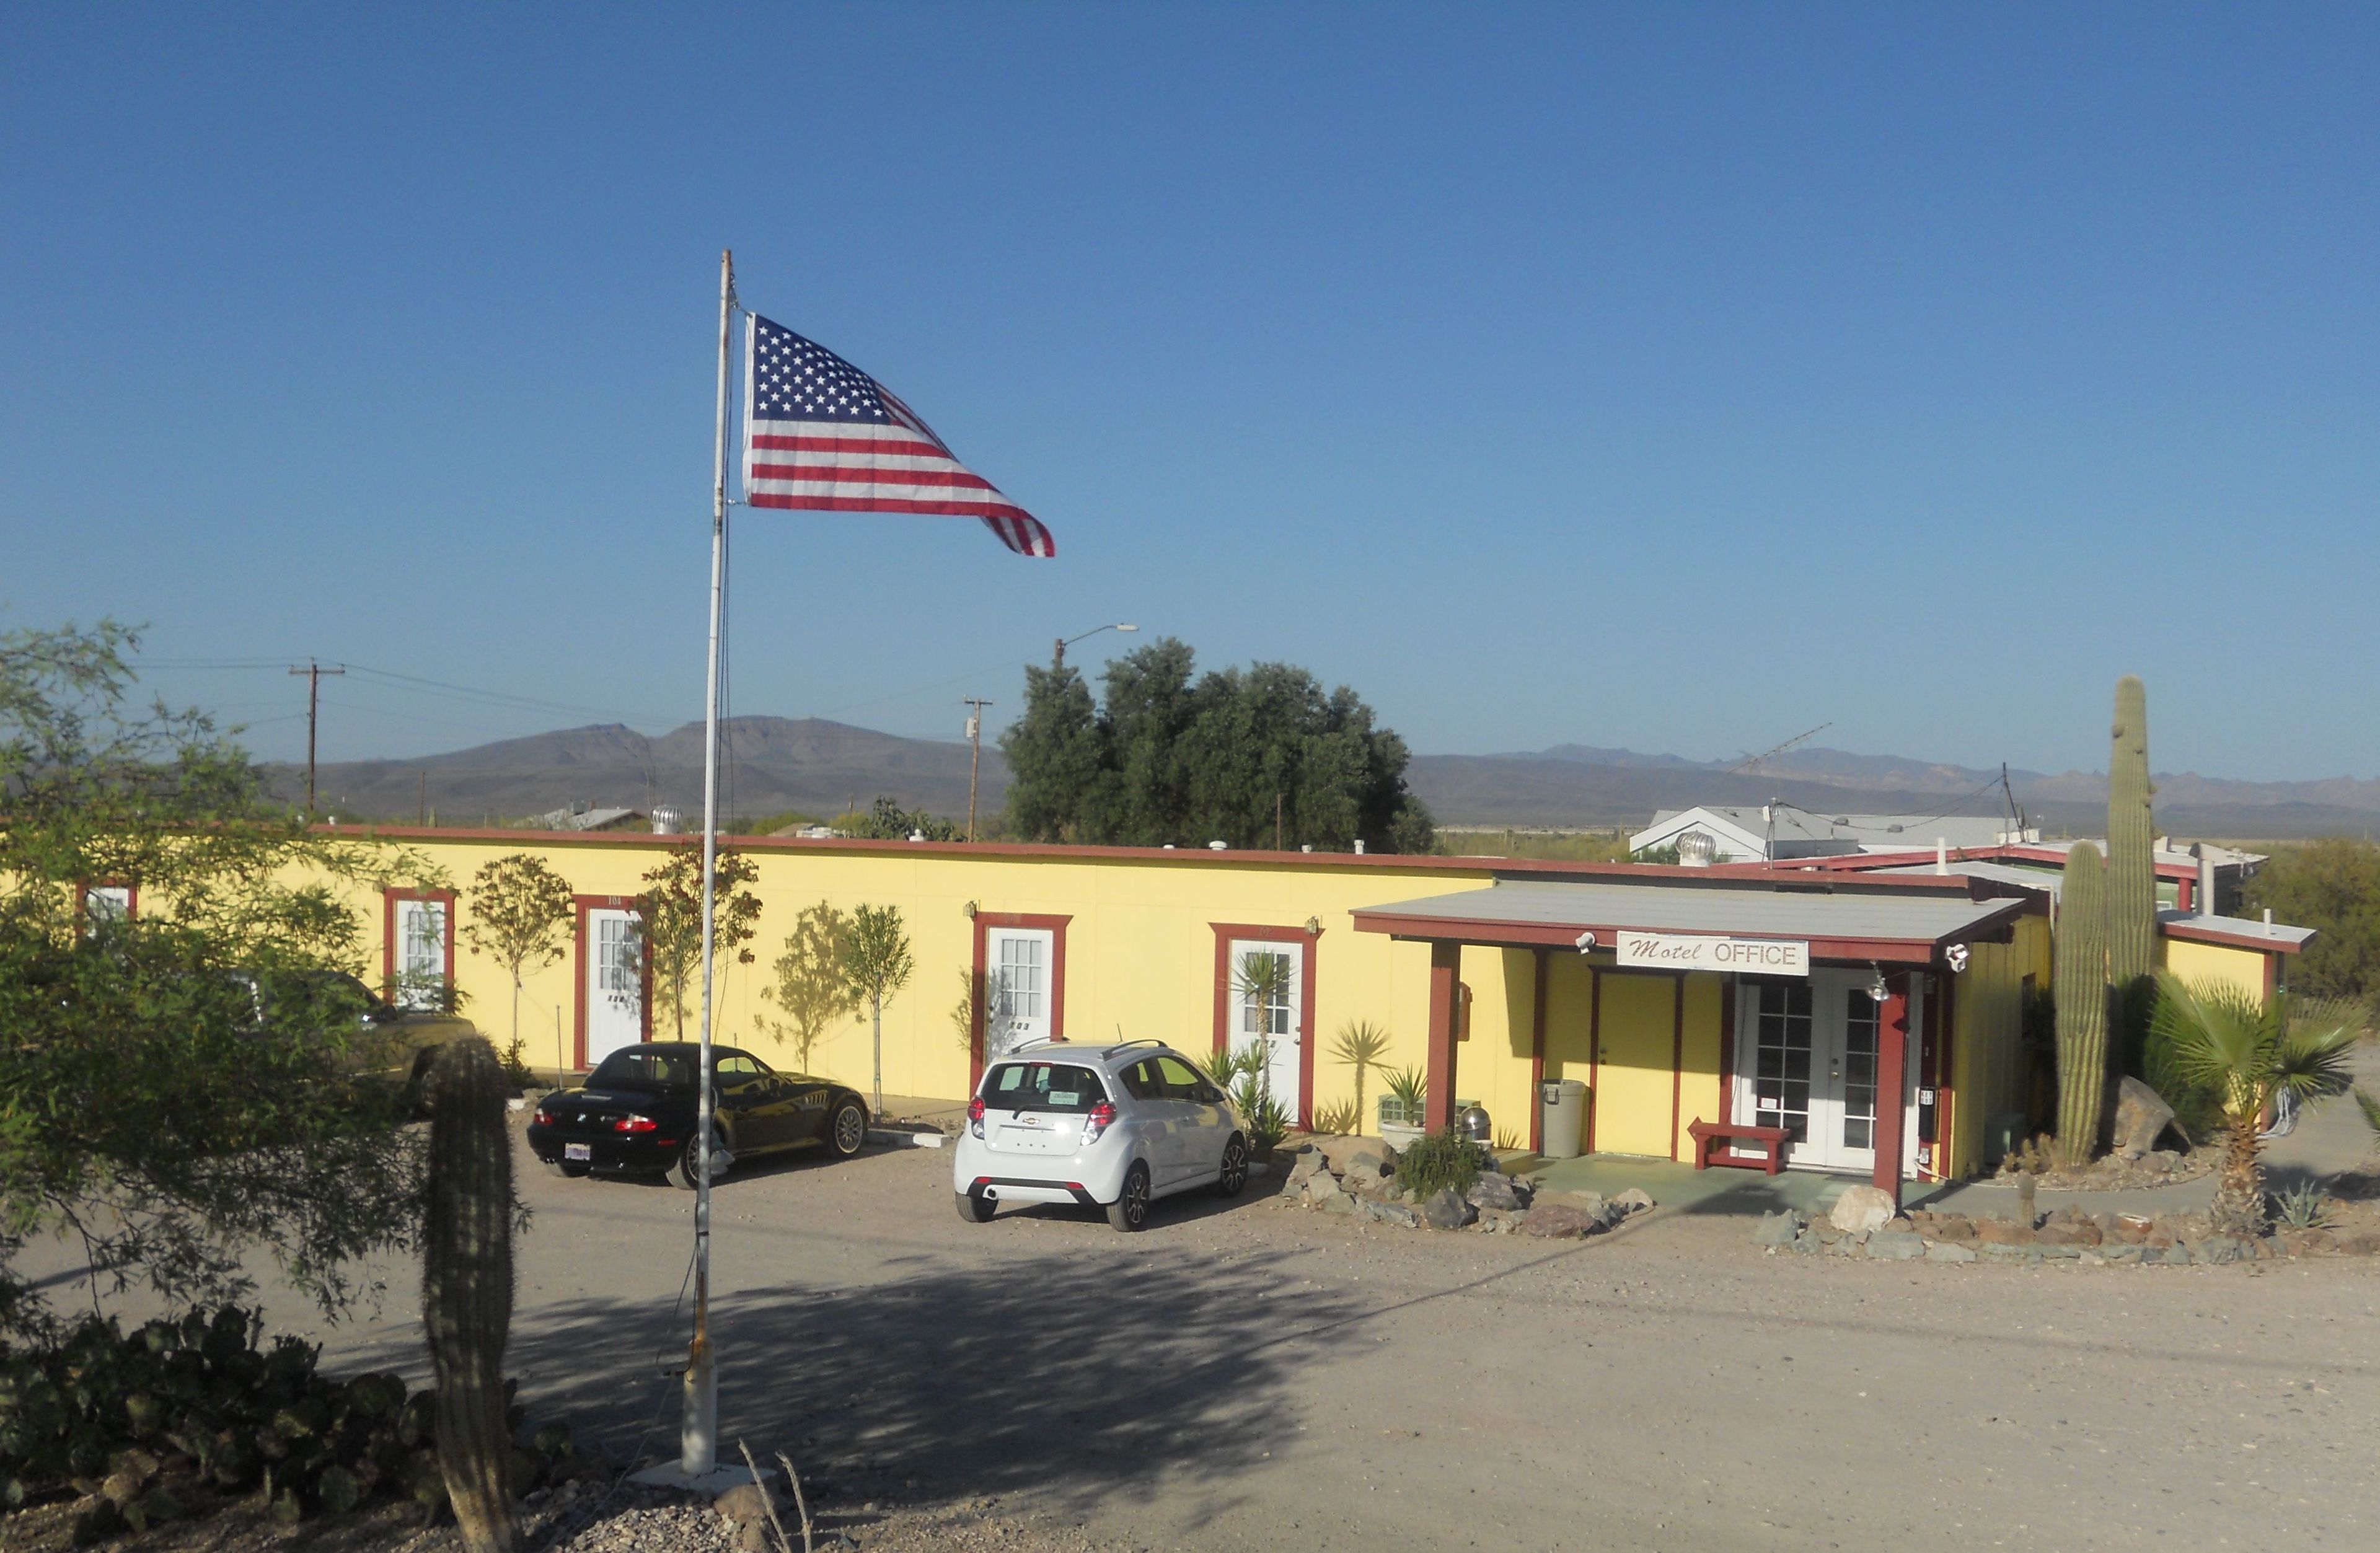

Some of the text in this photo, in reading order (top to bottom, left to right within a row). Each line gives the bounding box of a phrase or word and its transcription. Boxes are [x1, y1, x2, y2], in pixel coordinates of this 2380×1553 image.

[1629, 939, 1797, 966] Motel OFFICE
[1010, 1022, 1029, 1031] 103
